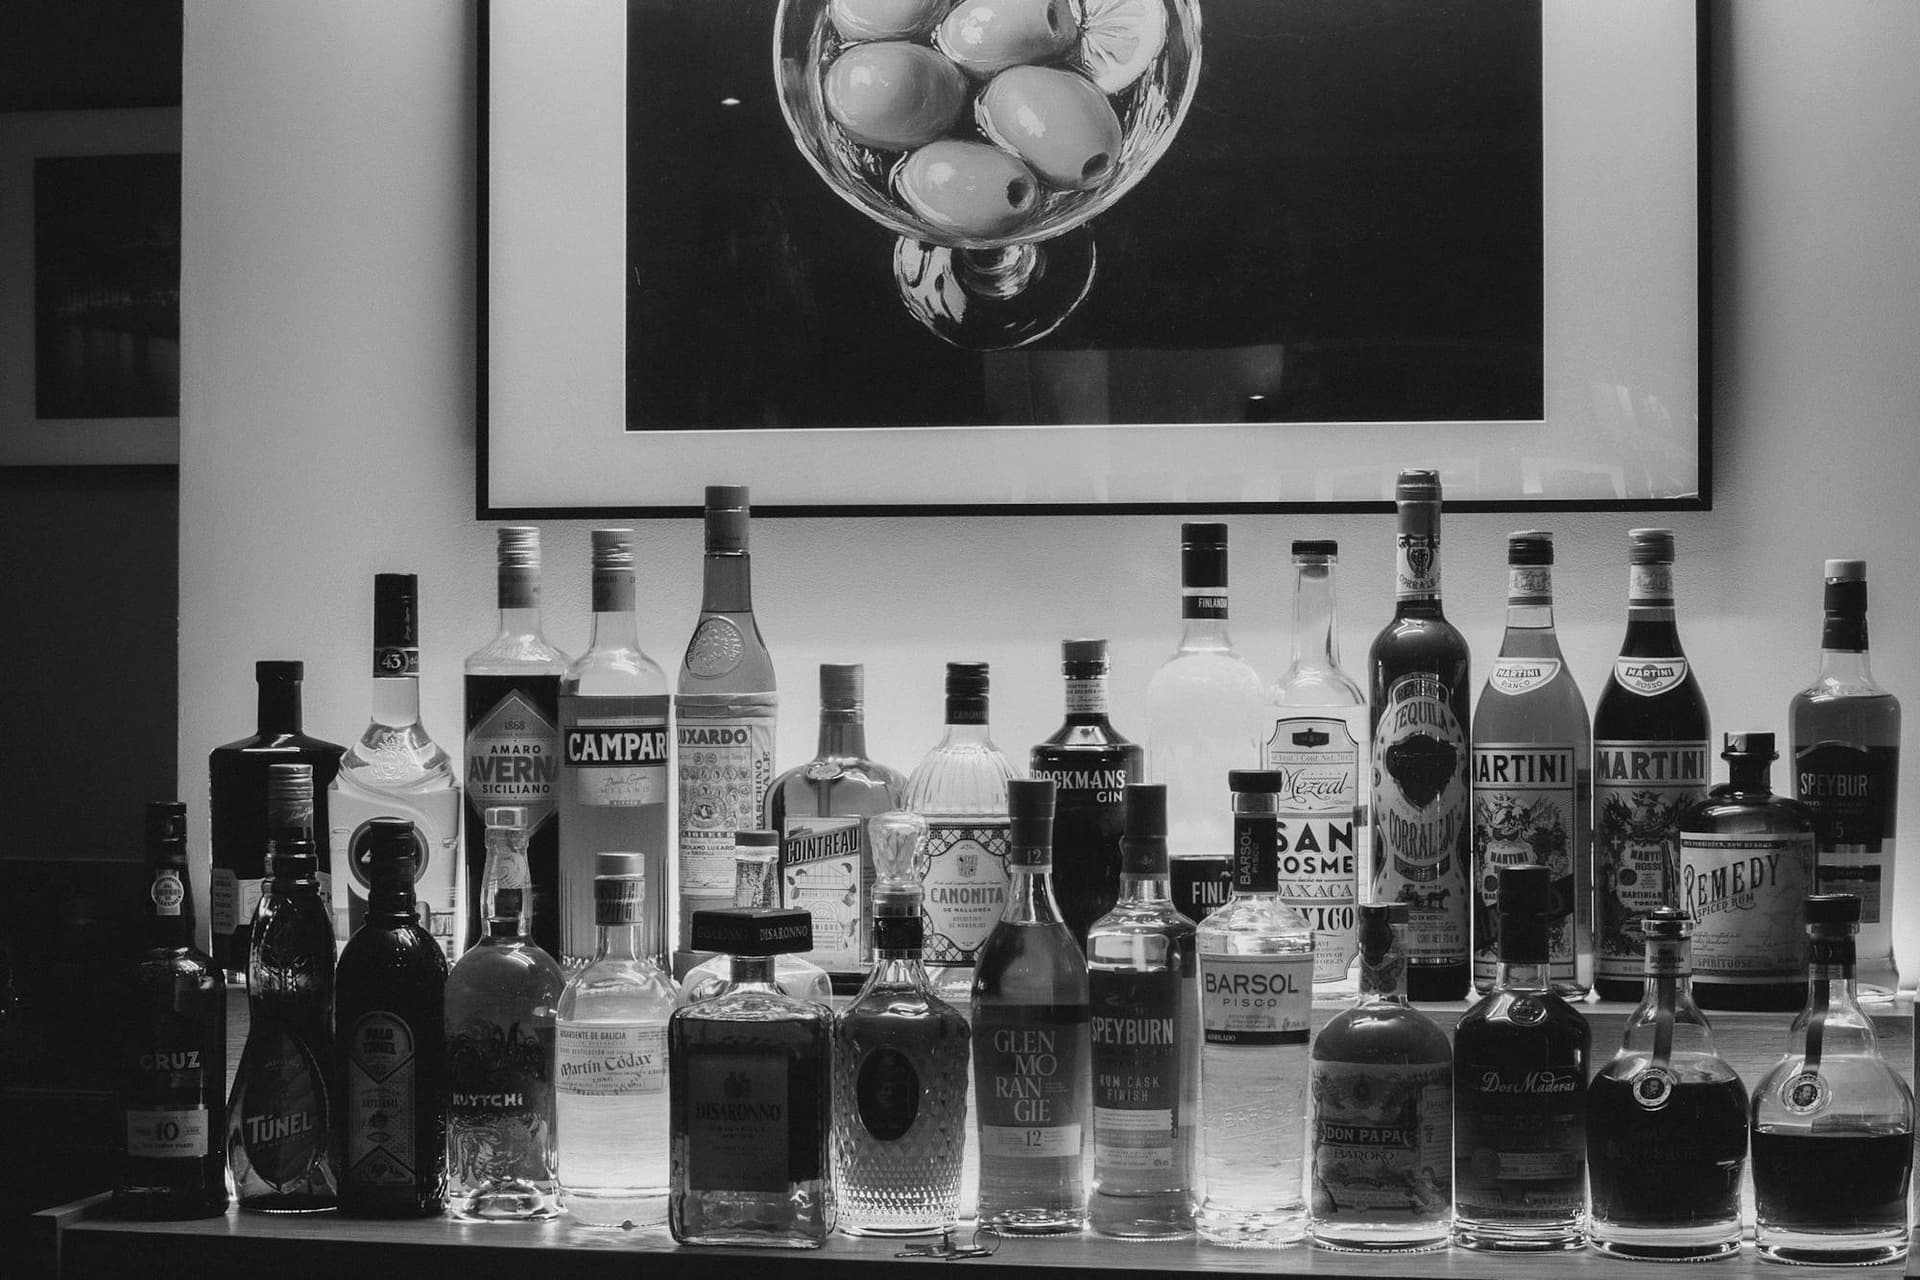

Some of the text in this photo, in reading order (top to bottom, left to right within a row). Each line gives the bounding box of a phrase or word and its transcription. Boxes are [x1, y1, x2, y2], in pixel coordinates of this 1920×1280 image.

[382, 653, 401, 669] 43
[1497, 669, 1539, 677] MARTINI
[1627, 668, 1672, 677] MARTINI
[1635, 680, 1663, 689] ROSSO
[1394, 701, 1449, 734] TEQUILA
[490, 745, 541, 754] AMARO
[482, 784, 550, 794] SICILIANO
[1277, 766, 1351, 803] Mezcal
[1800, 772, 1868, 797] SPEYBUR
[1097, 791, 1123, 803] GIN
[786, 827, 859, 864] COINTREAU
[1277, 822, 1353, 852] SAN
[1028, 849, 1042, 864] 12
[1240, 826, 1251, 885] BARSOL
[1277, 856, 1354, 874] OSME
[931, 887, 1004, 905] CANONITA
[1683, 853, 1780, 924] REMEDY
[1697, 902, 1729, 918] SPICED
[760, 925, 808, 942] DISARONNO
[1205, 973, 1299, 994] BARSOL
[1223, 999, 1277, 1008] PISCO
[1091, 1016, 1174, 1045] SPEYBURN
[994, 1030, 1055, 1053] GLEN
[140, 1051, 201, 1070] CRUZ
[561, 1060, 601, 1077] Martín
[1015, 1054, 1057, 1076] MO
[996, 1077, 1042, 1098] RAN
[1128, 1075, 1160, 1088] CASK
[696, 1102, 782, 1120] DISARONNO
[1014, 1099, 1051, 1121] GIE
[156, 1120, 179, 1142] 10
[247, 1111, 313, 1144] TÚNEL
[1327, 1128, 1403, 1143] DON PAPA
[1026, 1130, 1041, 1146] 12
